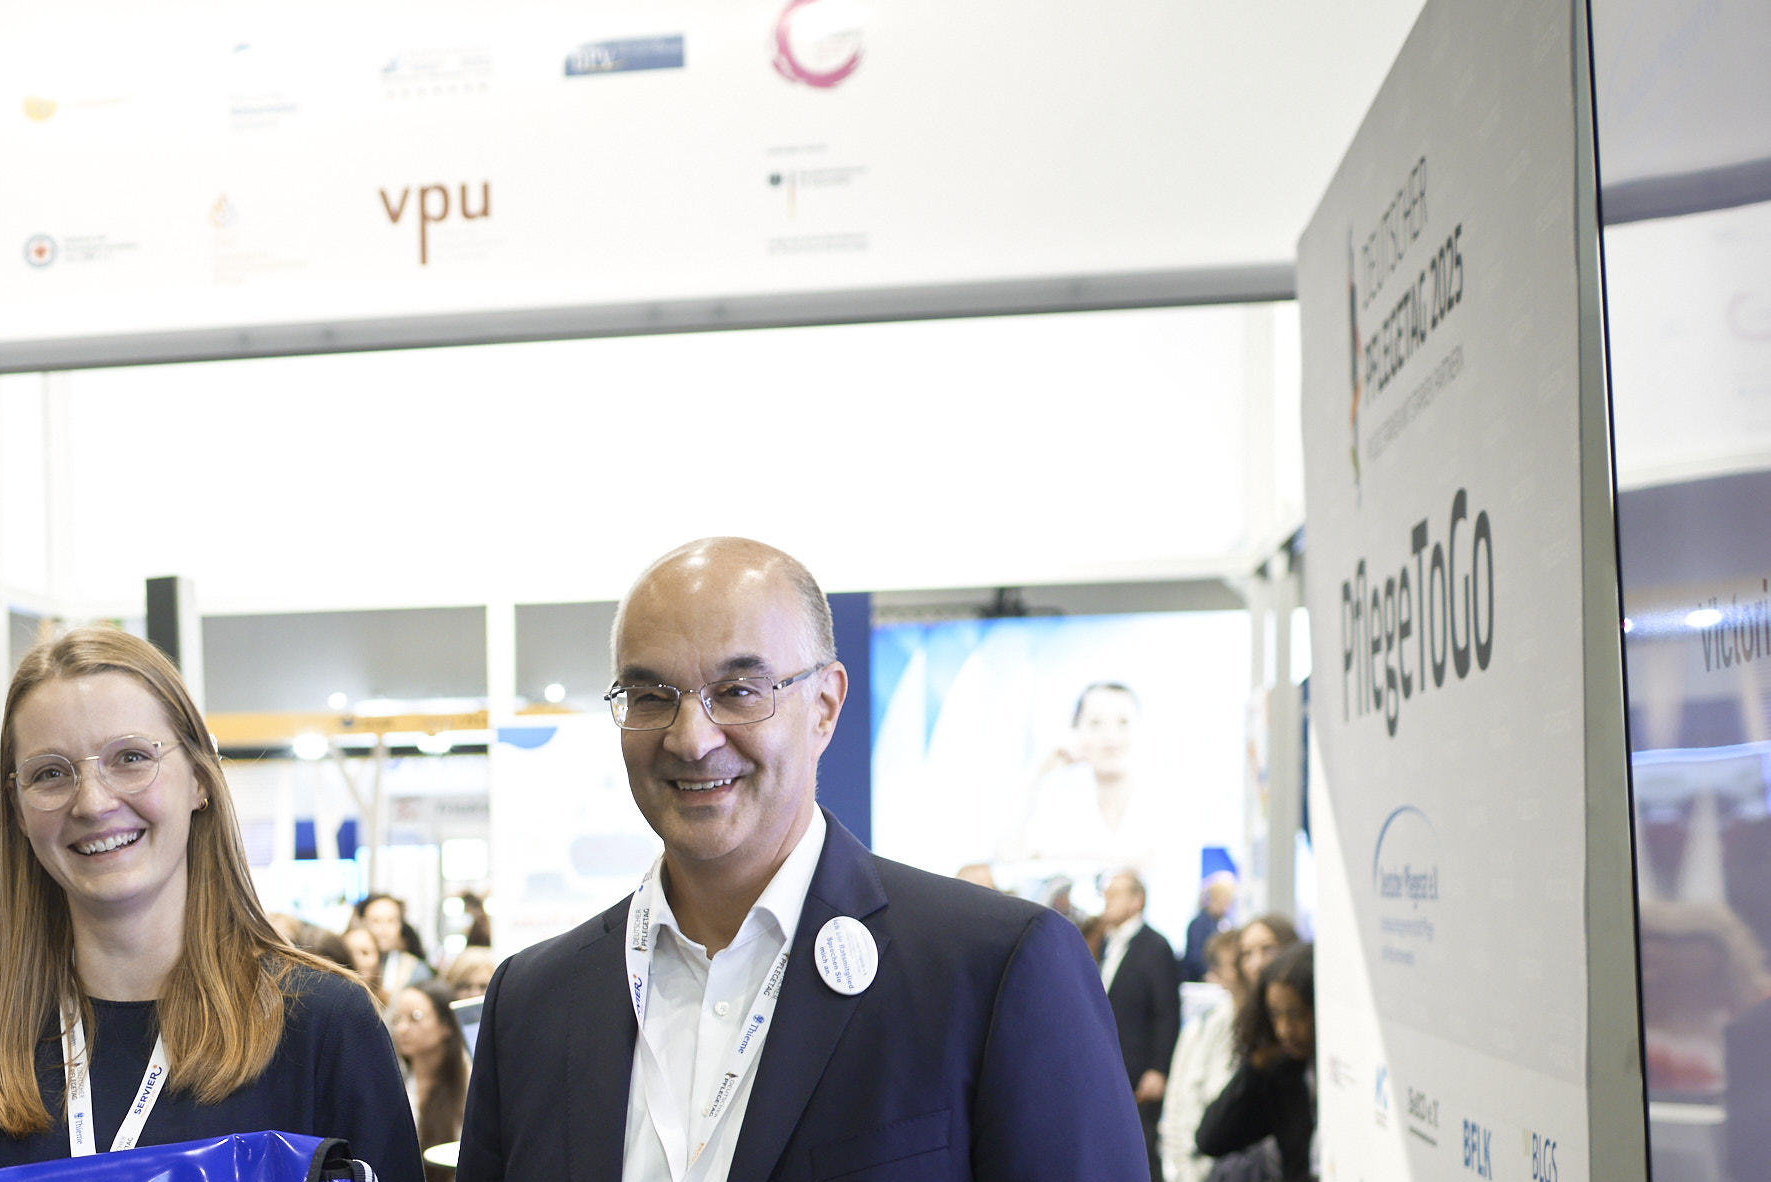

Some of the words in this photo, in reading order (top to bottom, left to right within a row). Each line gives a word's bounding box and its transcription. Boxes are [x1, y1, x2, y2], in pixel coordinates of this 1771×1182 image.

[379, 182, 490, 264] vpu
[1362, 155, 1428, 310] DEUTSCHER
[1365, 269, 1427, 406] PFLEGETAG
[1431, 222, 1463, 330] 2025
[1342, 487, 1494, 738] PflegeToGo
[632, 909, 642, 946] DEUTSCHER
[641, 908, 650, 947] PFLEGETAG
[820, 946, 828, 964] mich
[827, 936, 839, 970] Sprechen
[839, 944, 854, 991] Ratsmitglied.
[763, 957, 787, 997] PFLEGETAG
[738, 1024, 759, 1054] Thieme
[134, 1066, 163, 1115] SERVIER
[709, 1078, 729, 1117] PFLEGETAG
[713, 1079, 735, 1118] DEUTSCHER
[75, 1118, 83, 1145] Thieme
[1463, 1118, 1492, 1181] BFLK
